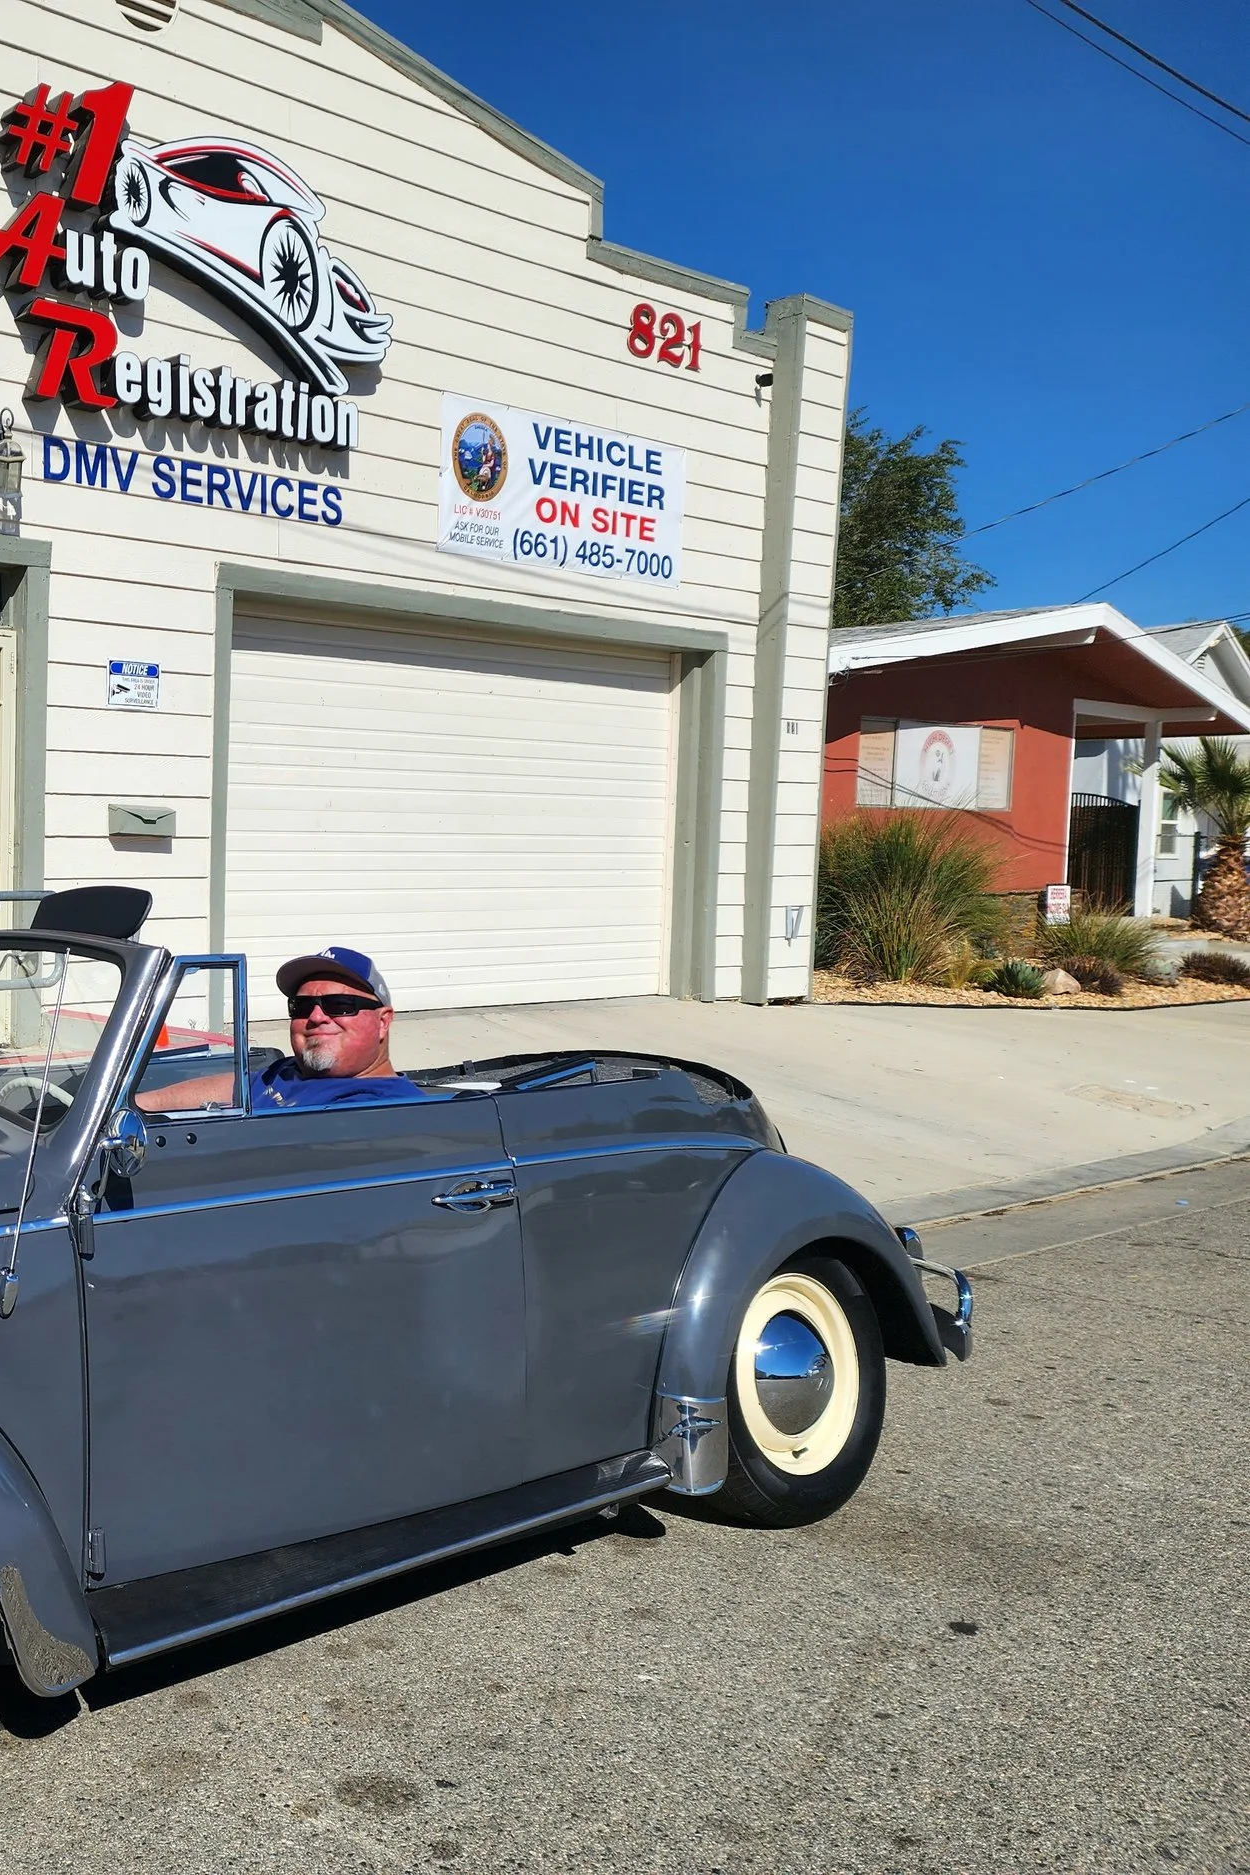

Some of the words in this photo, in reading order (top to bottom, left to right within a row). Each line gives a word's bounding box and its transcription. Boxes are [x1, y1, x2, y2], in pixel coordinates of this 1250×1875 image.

[6, 81, 135, 207] #1
[627, 303, 702, 372] 821
[30, 298, 359, 449] Registration
[532, 422, 662, 475] VEHICLE
[43, 437, 139, 493] DMV
[151, 455, 343, 526] SERVICES
[528, 458, 665, 510] VERIFIER
[454, 504, 468, 515] LIC
[454, 520, 469, 531] ASK
[470, 523, 484, 534] FOR
[485, 525, 500, 536] OUR
[536, 497, 579, 528] ON
[591, 507, 656, 542] SITE
[449, 531, 476, 545] MOBILE
[476, 535, 504, 549] SERVICE
[513, 528, 568, 567] (661)
[575, 540, 672, 579] 485-7000
[121, 663, 149, 676] NOTICE
[137, 691, 152, 699] VIDEO
